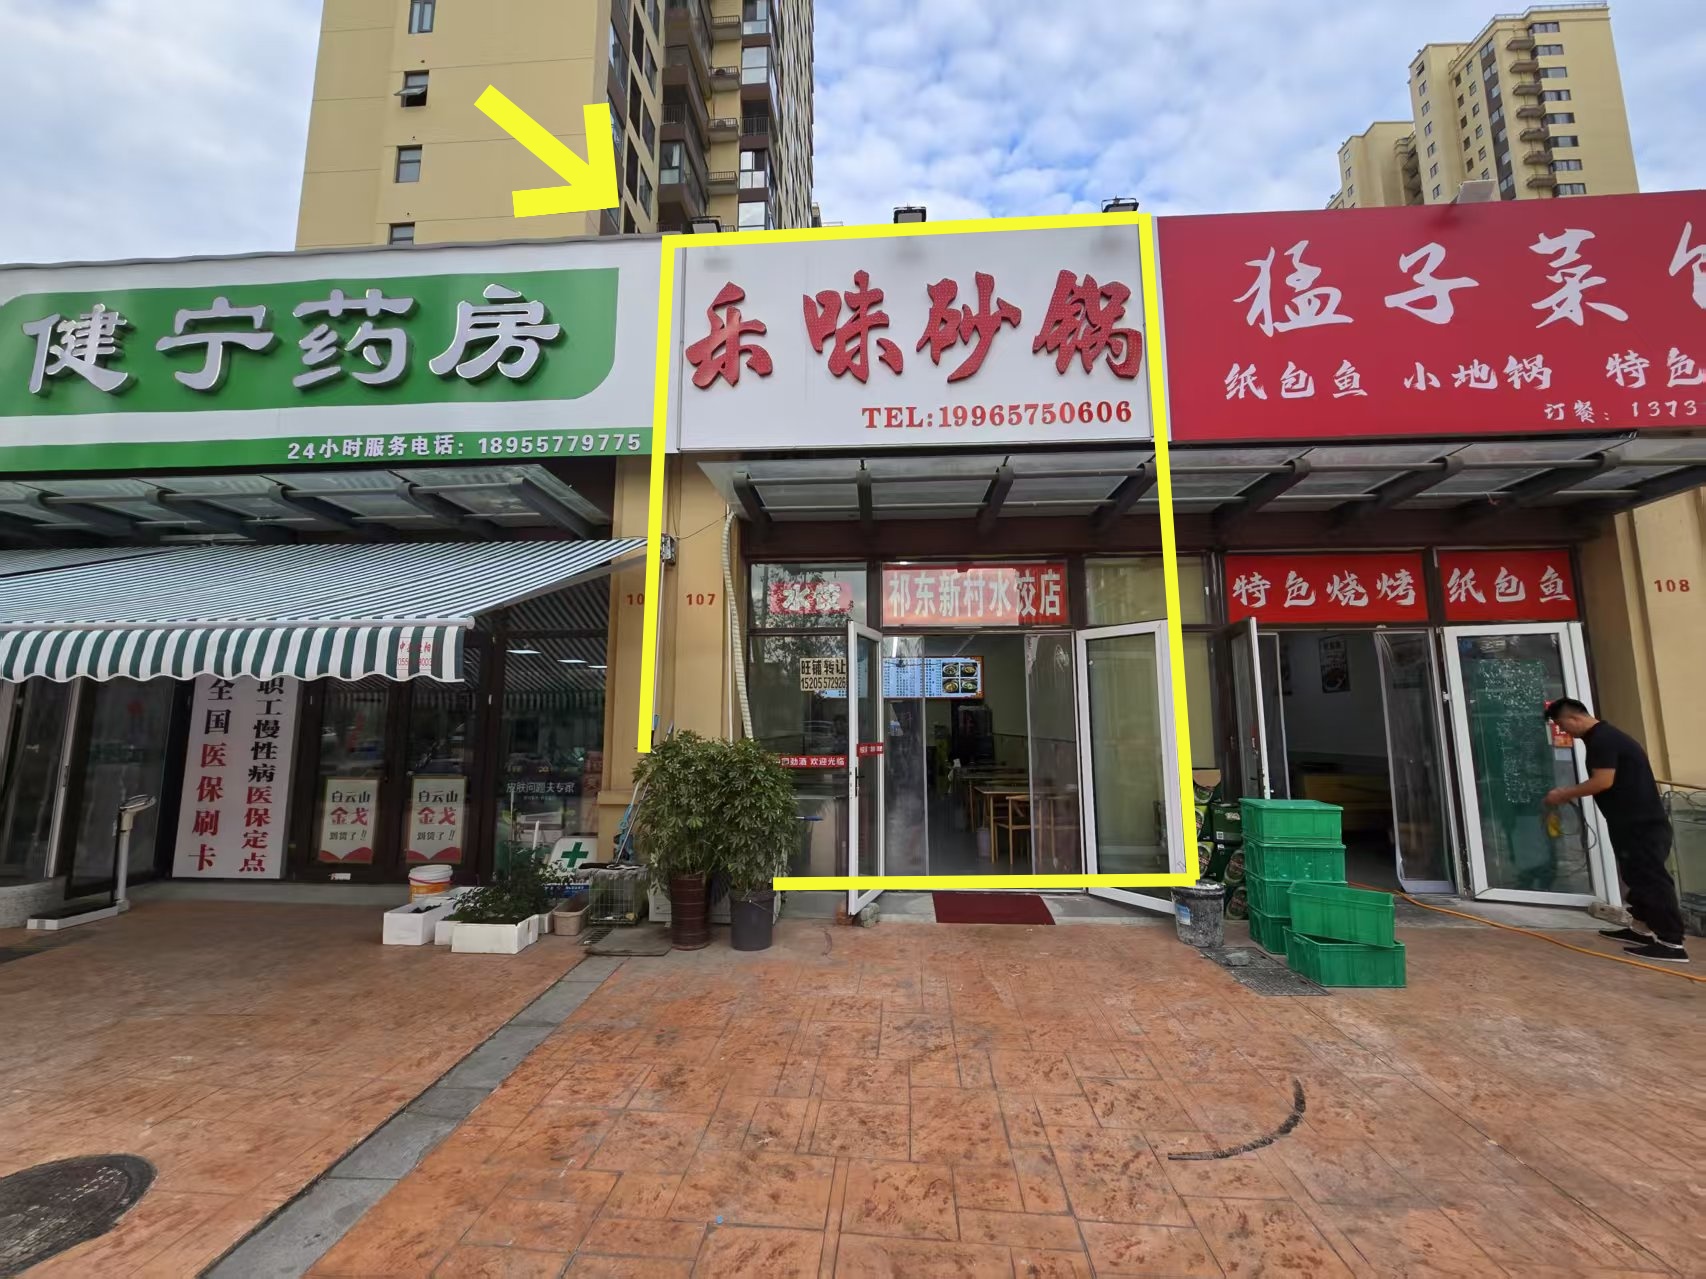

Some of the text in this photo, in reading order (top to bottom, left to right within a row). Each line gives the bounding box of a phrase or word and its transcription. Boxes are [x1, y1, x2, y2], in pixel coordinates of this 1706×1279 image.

[22, 284, 562, 395] 健宁药房
[685, 269, 1143, 390] 乐味砂锅
[1223, 359, 1369, 401] 纸包鱼
[1403, 353, 1553, 391] 小地锅
[861, 400, 1132, 429] TEL:19965750606
[1631, 400, 1698, 417] 1373
[478, 433, 643, 454] 18955779775
[889, 568, 1061, 617] 祁东新村水饺店
[1232, 568, 1417, 608] 特色烧烤
[1446, 565, 1571, 602] 纸包鱼
[1654, 579, 1690, 592] 108
[686, 593, 716, 606] 107
[801, 659, 846, 675] 旺铺转让
[188, 678, 236, 871] 全国医保刷卡
[332, 790, 371, 803] 白云山
[418, 790, 458, 803] 白云山
[330, 806, 369, 826] 金戈
[417, 806, 457, 826] 金戈
